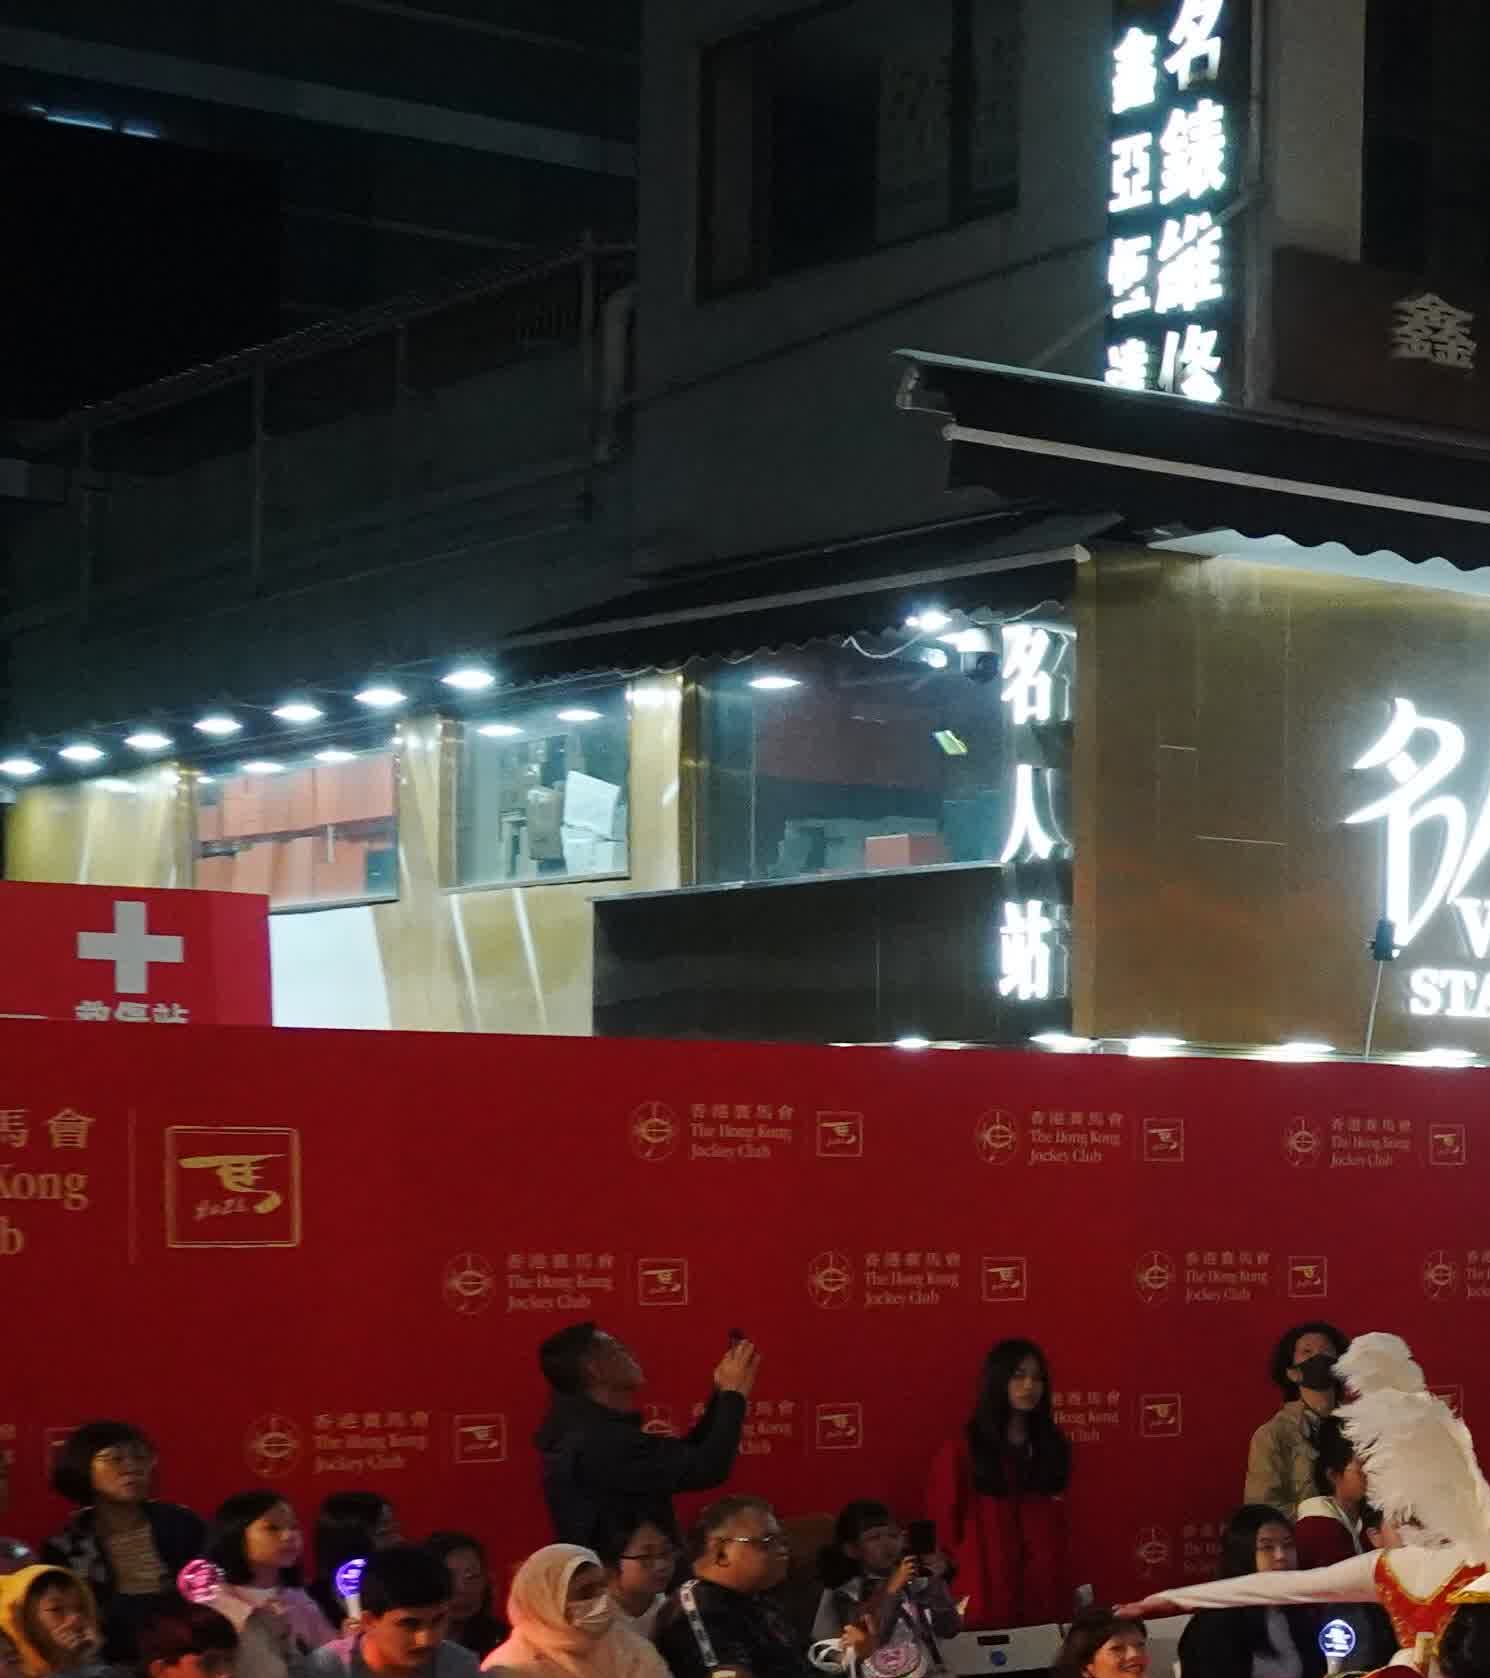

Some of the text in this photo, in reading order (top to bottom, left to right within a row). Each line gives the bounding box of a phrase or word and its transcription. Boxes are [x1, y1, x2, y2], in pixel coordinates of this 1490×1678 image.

[1001, 624, 1058, 1001] 名人站
[1030, 1130, 1121, 1148] The Hong Kong
[1029, 1149, 1103, 1167] Jockey Club
